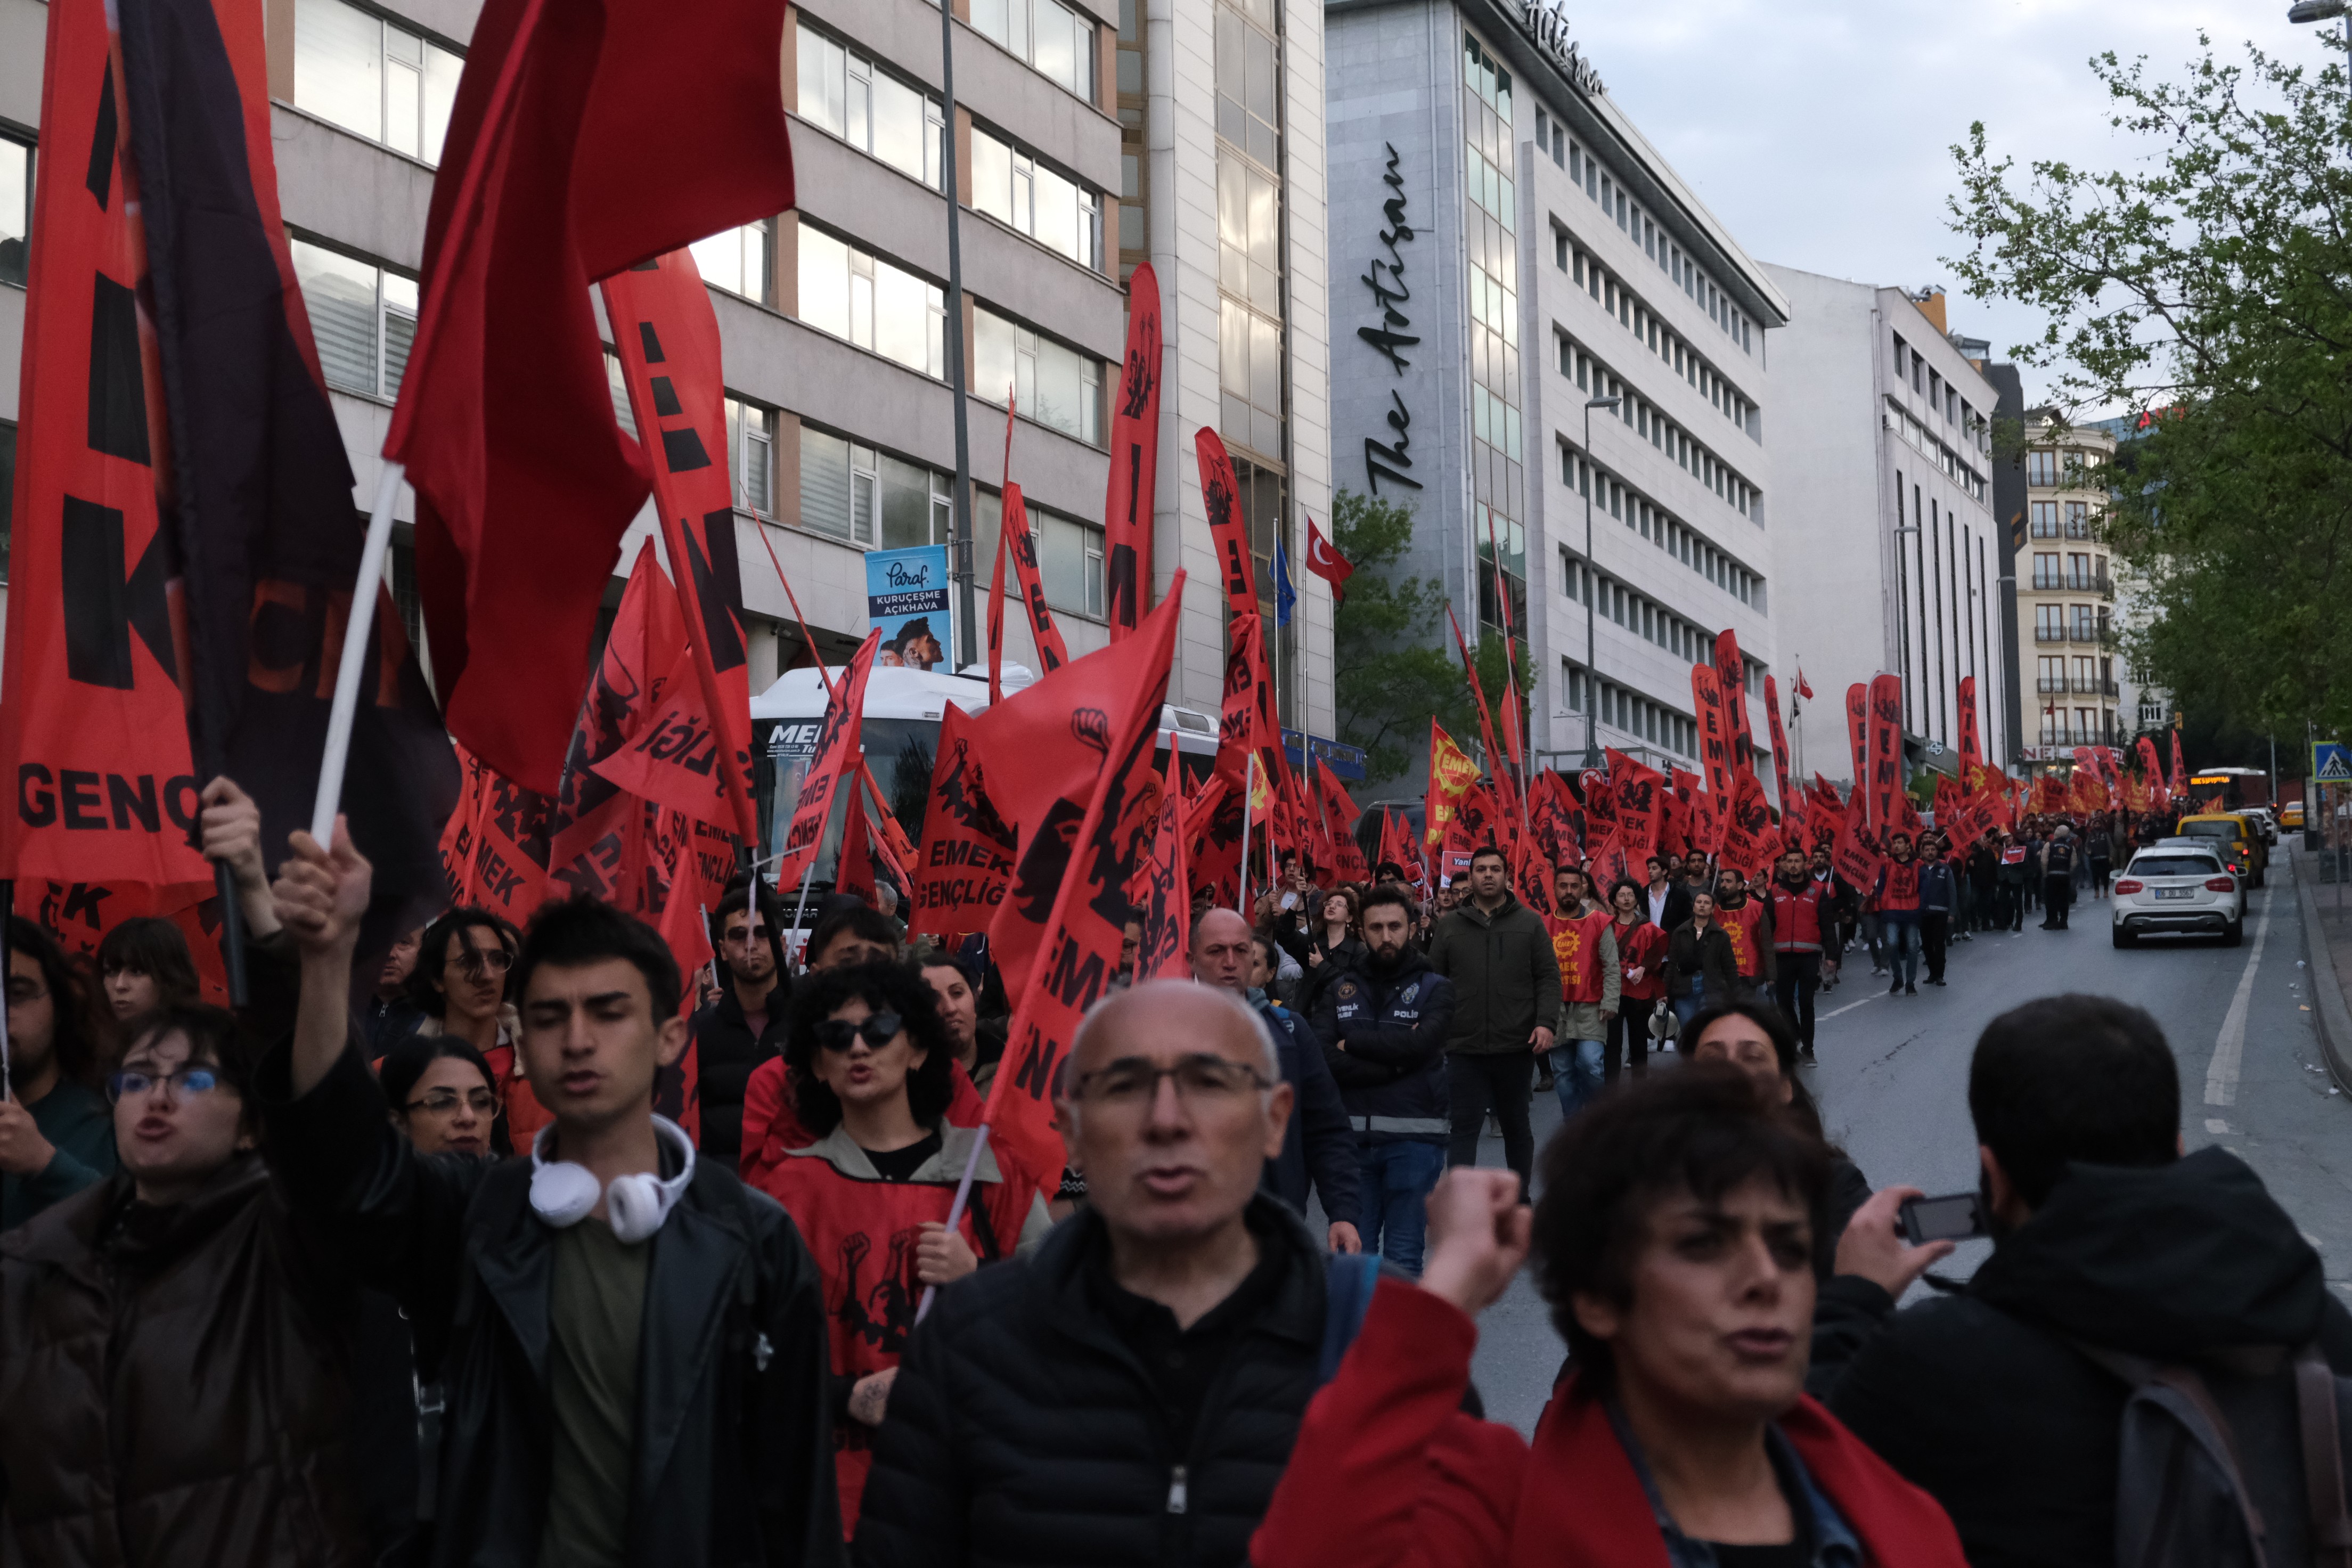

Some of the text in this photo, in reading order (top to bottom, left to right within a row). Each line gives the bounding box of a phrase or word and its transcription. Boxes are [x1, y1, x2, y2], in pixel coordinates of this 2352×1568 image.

[1357, 141, 1423, 495] The Artisan
[877, 591, 941, 605] KURUÇEŞME
[884, 602, 938, 615] AÇIKHAVA
[930, 840, 1015, 877] EMEK
[1844, 848, 1871, 870] EMEK
[1394, 1010, 1419, 1018] POLİS
